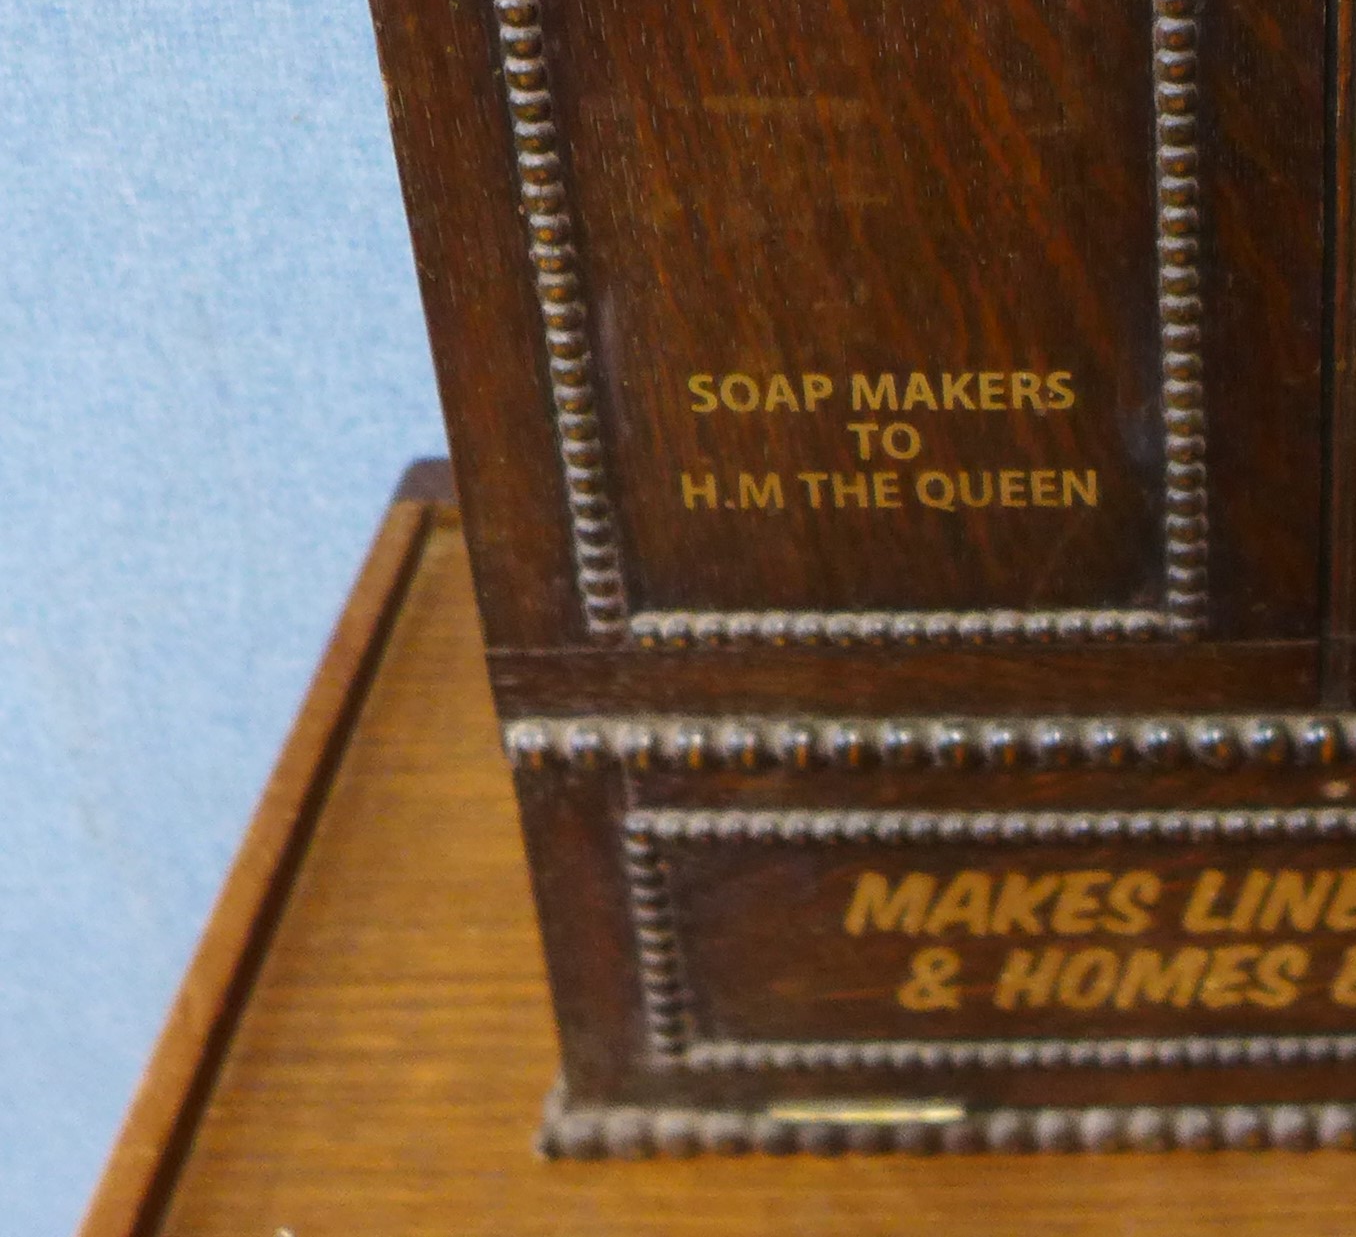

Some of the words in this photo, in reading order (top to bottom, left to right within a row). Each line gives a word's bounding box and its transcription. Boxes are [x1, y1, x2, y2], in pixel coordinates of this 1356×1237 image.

[687, 372, 834, 415] SOAP
[851, 370, 1076, 413] MAKERS
[846, 421, 923, 461] TO
[681, 471, 785, 511] H.M
[797, 470, 903, 509] THE
[915, 469, 1099, 512] QUEEN
[844, 869, 1165, 937] MAKES
[897, 945, 963, 1011] &
[993, 943, 1311, 1011] HOMES
